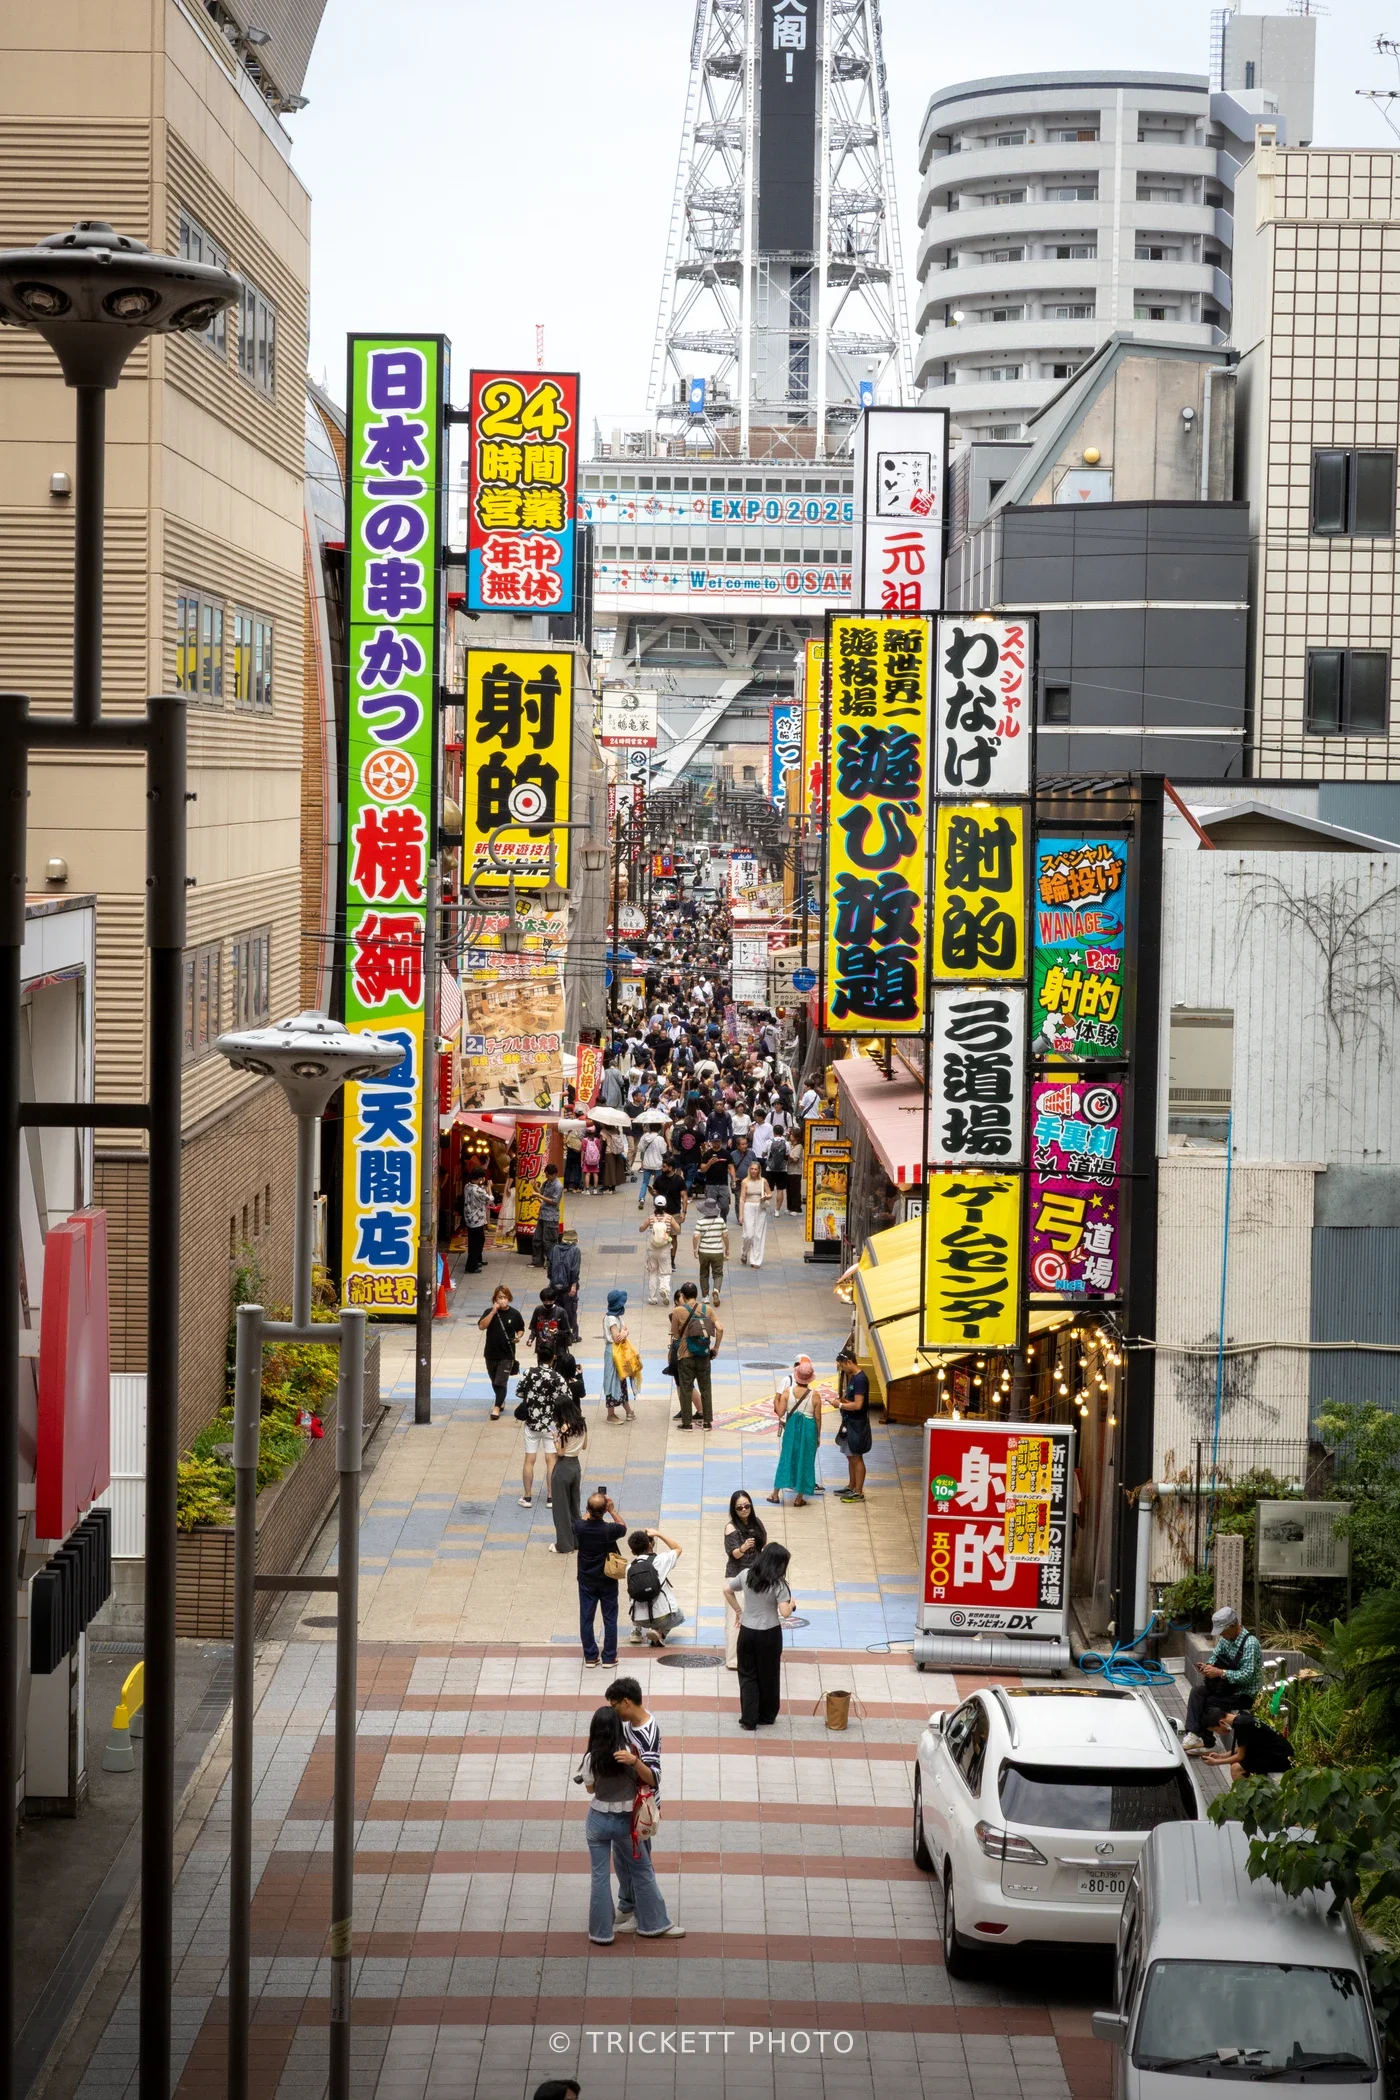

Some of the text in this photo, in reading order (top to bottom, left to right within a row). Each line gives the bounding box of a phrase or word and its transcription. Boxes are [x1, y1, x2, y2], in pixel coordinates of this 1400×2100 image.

[480, 381, 568, 440] 24
[480, 443, 566, 485] 時間
[479, 487, 564, 531] 営業
[711, 499, 853, 522] EXPO 2025
[359, 350, 426, 743] 日本一の串かつ
[486, 538, 560, 570] 年中
[486, 571, 560, 602] 無休
[690, 570, 761, 590] Welcome
[764, 577, 777, 590] to
[881, 532, 926, 620] 元祖
[838, 627, 878, 717] 遊技場
[882, 627, 923, 717] 新世界一
[997, 626, 1024, 738] スペシャル
[944, 627, 1000, 787] わなげ
[472, 663, 562, 837] 射的
[833, 724, 921, 1021] 遊び放題
[1041, 845, 1113, 873] スペシャル
[942, 815, 1016, 970] 射的
[1039, 862, 1123, 905] 輪投げ
[352, 808, 427, 1007] 横綱
[1038, 910, 1103, 946] WANAGE
[1039, 966, 1121, 1022] 射的
[1075, 1019, 1119, 1048] 体験
[579, 1050, 595, 1101] たい焼き
[942, 999, 1013, 1156] 弓道場
[1067, 1154, 1116, 1186] 道場
[936, 1182, 1014, 1339] ゲームセンター
[348, 1274, 418, 1306] 新世界
[1055, 1279, 1085, 1292] NICE!
[1006, 1615, 1039, 1629] DX
[1089, 1880, 1125, 1892] 80-00
